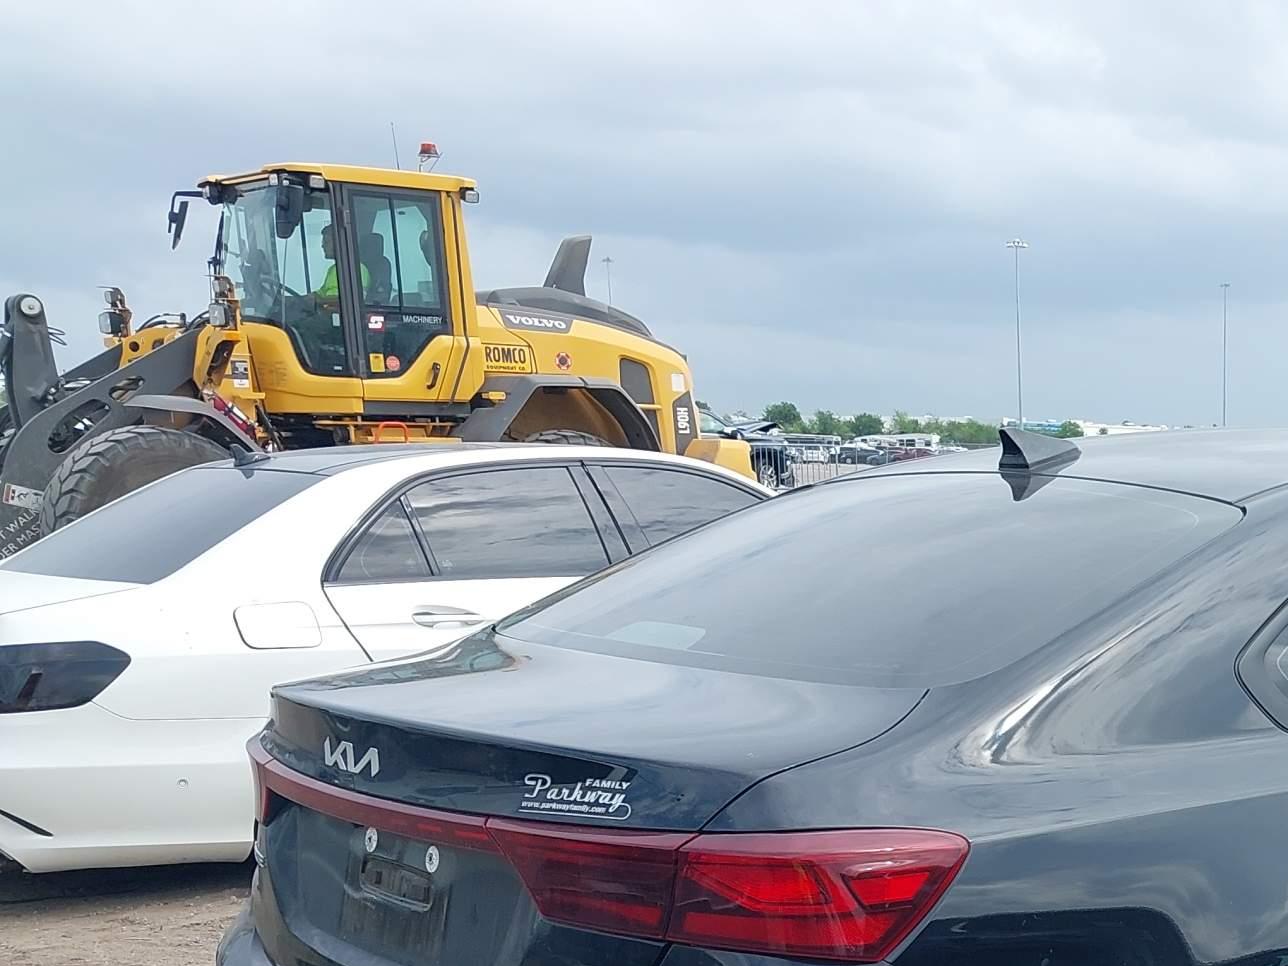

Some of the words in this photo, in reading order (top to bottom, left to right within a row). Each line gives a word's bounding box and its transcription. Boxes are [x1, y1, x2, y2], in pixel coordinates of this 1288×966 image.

[402, 315, 443, 325] MACHINERY
[505, 314, 567, 329] VOLVO
[484, 346, 526, 364] ROMCO
[676, 407, 691, 434] L90H
[323, 736, 380, 778] KIA
[585, 778, 632, 791] FAMILY
[523, 773, 626, 813] Parkway
[520, 800, 607, 814] www.parkwayfamily.com
